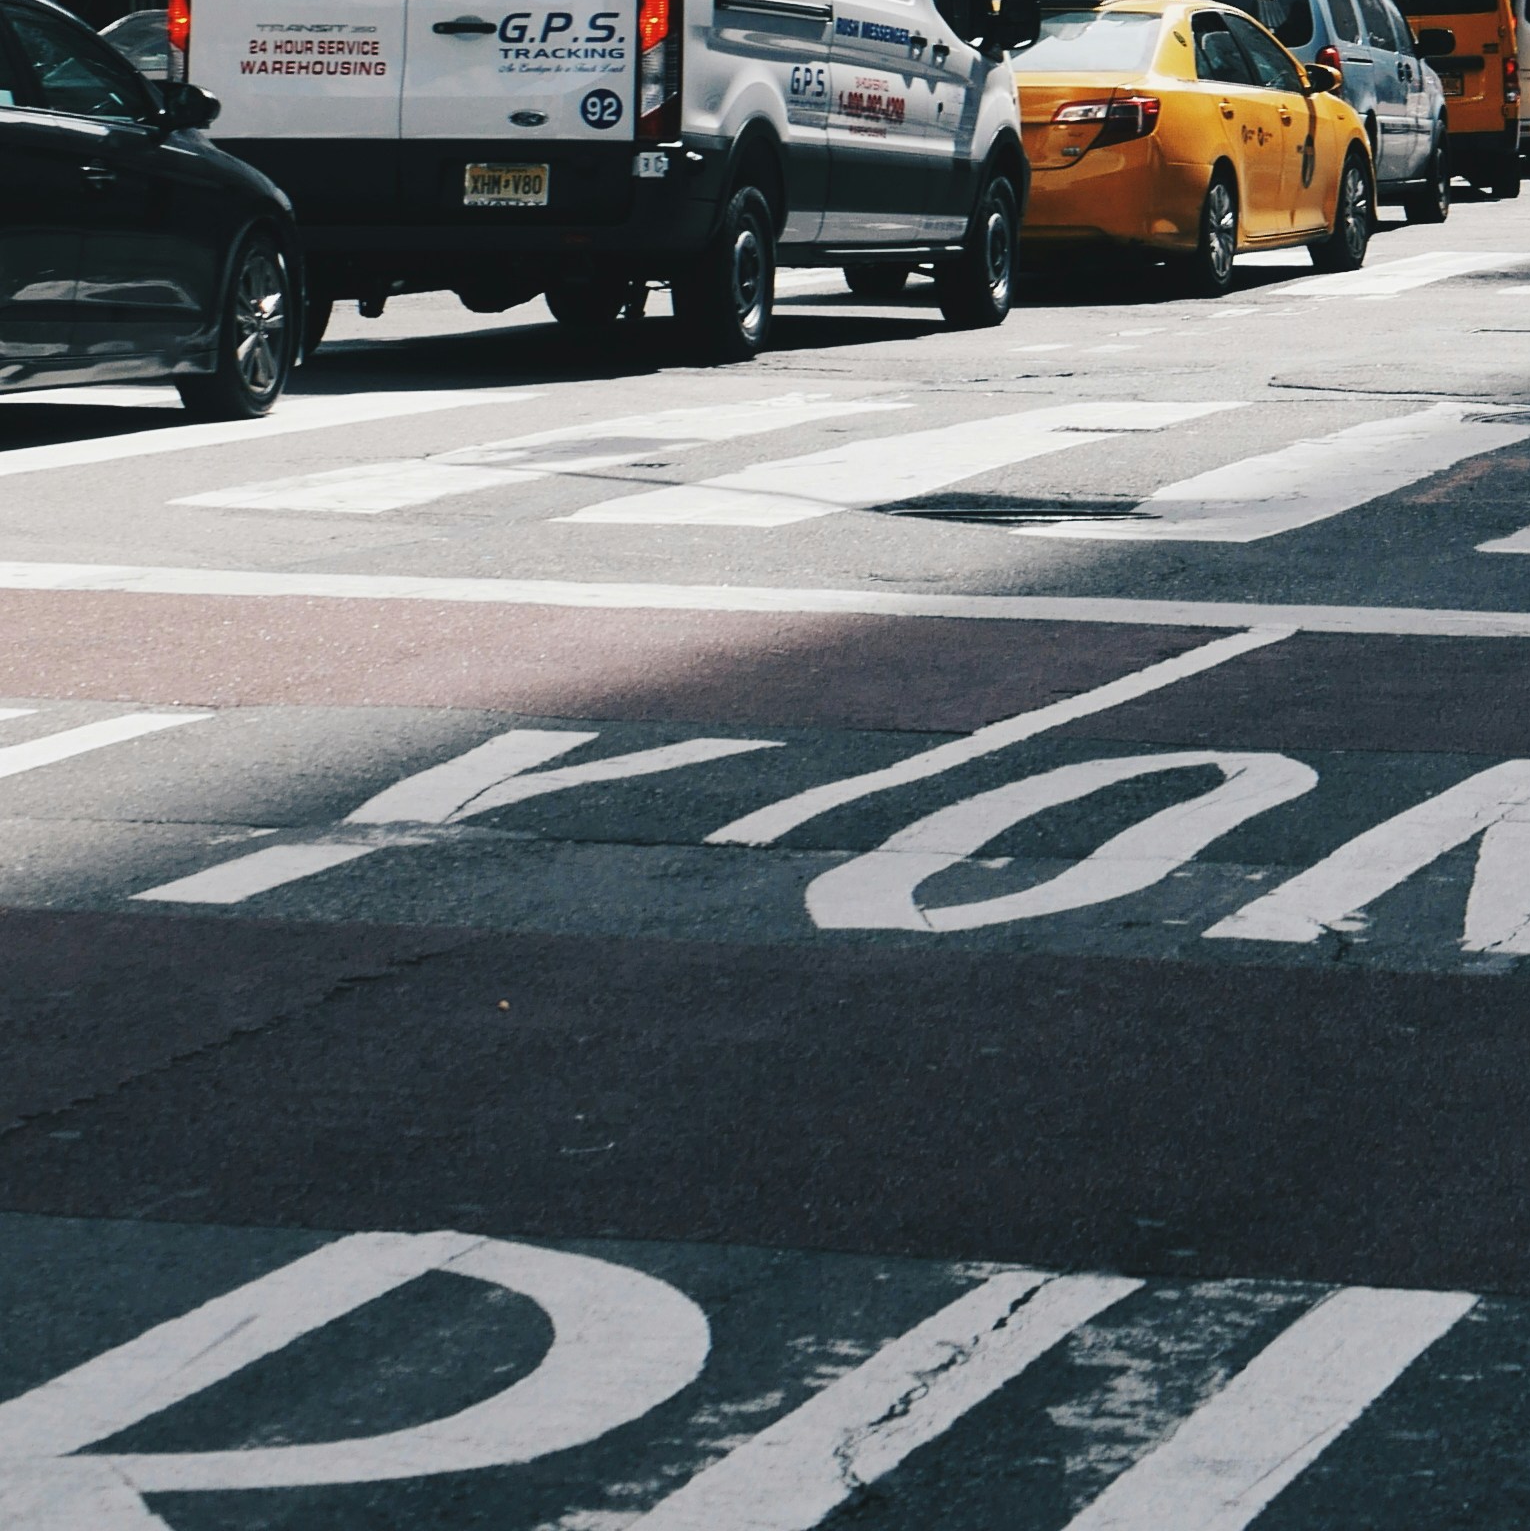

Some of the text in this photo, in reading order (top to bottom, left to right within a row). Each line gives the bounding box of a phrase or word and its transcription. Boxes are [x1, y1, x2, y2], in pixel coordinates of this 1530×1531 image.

[256, 24, 347, 33] TRANSIT
[499, 12, 626, 44] G.P.S.
[249, 41, 380, 55] 24 HOUR SERVICE
[499, 48, 625, 59] TRACKING
[240, 61, 386, 76] WAREHOUSING
[586, 97, 618, 121] 92
